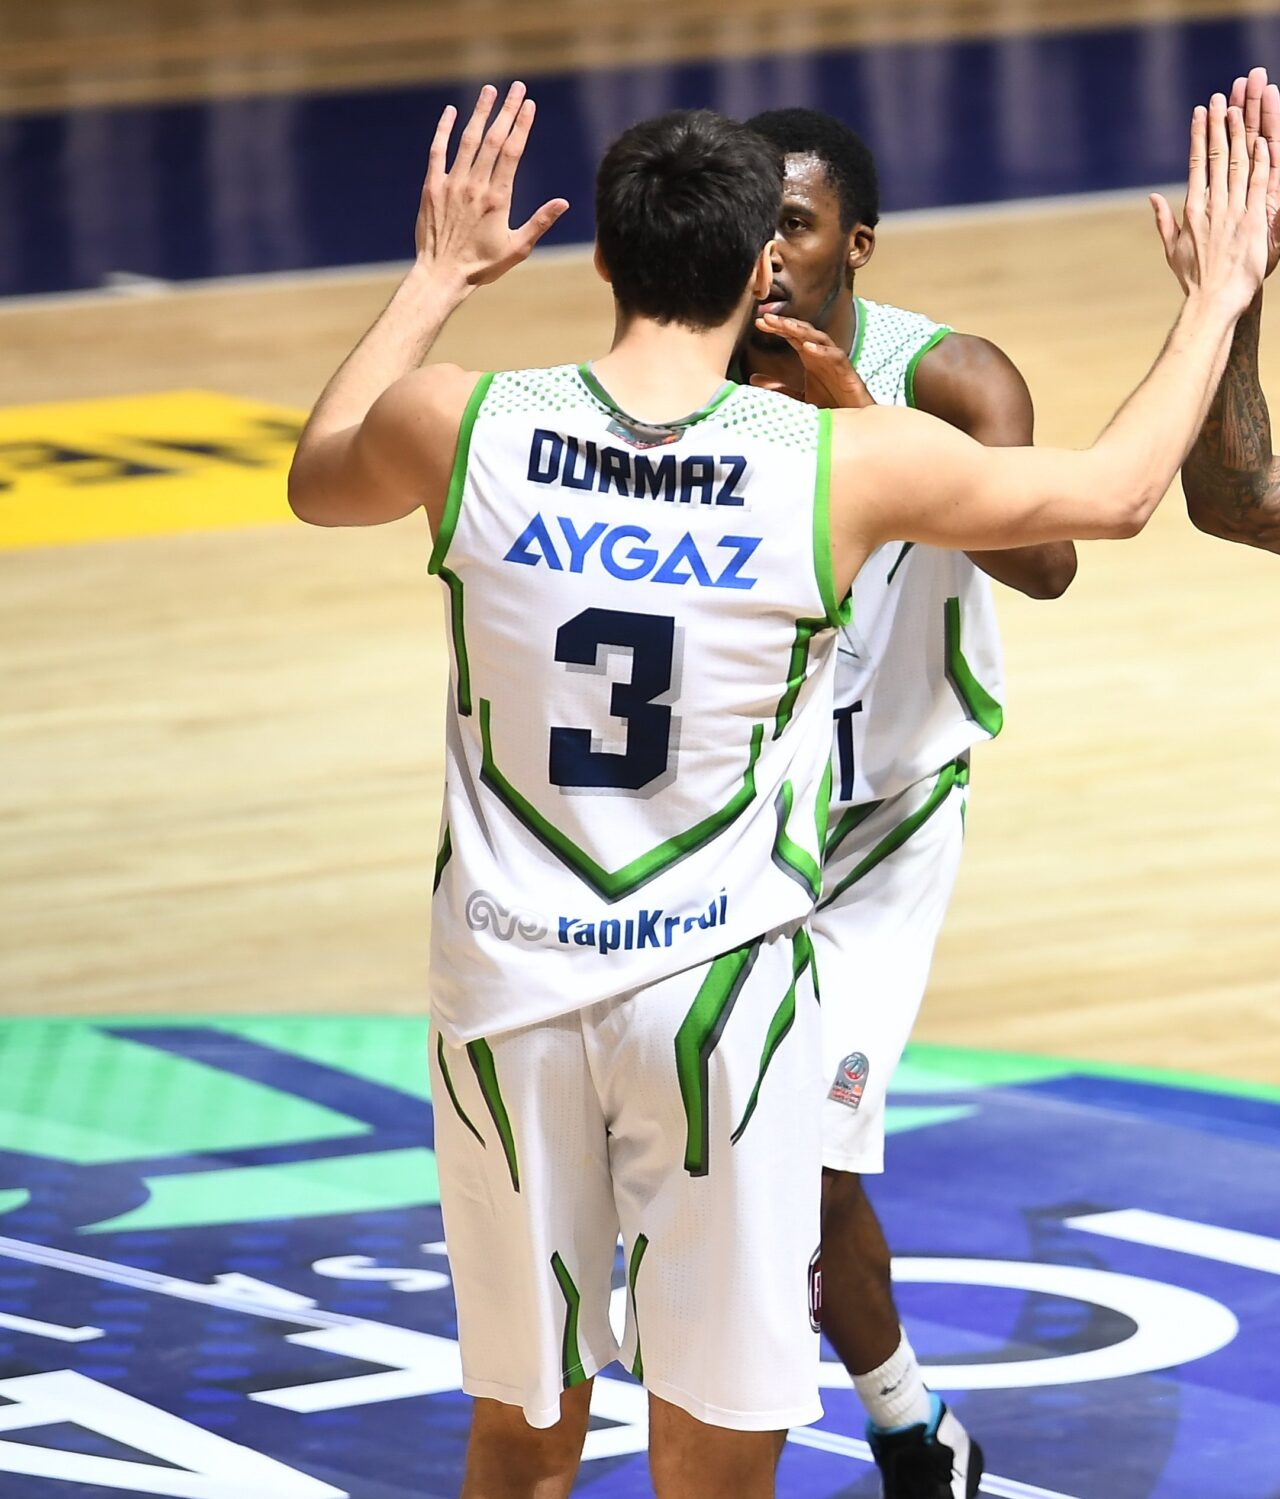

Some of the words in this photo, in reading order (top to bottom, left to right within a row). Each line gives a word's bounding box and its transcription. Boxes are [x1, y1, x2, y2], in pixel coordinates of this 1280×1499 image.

[527, 428, 748, 507] DURMAZ
[503, 512, 764, 590] AYGAZ
[549, 607, 680, 791] 3
